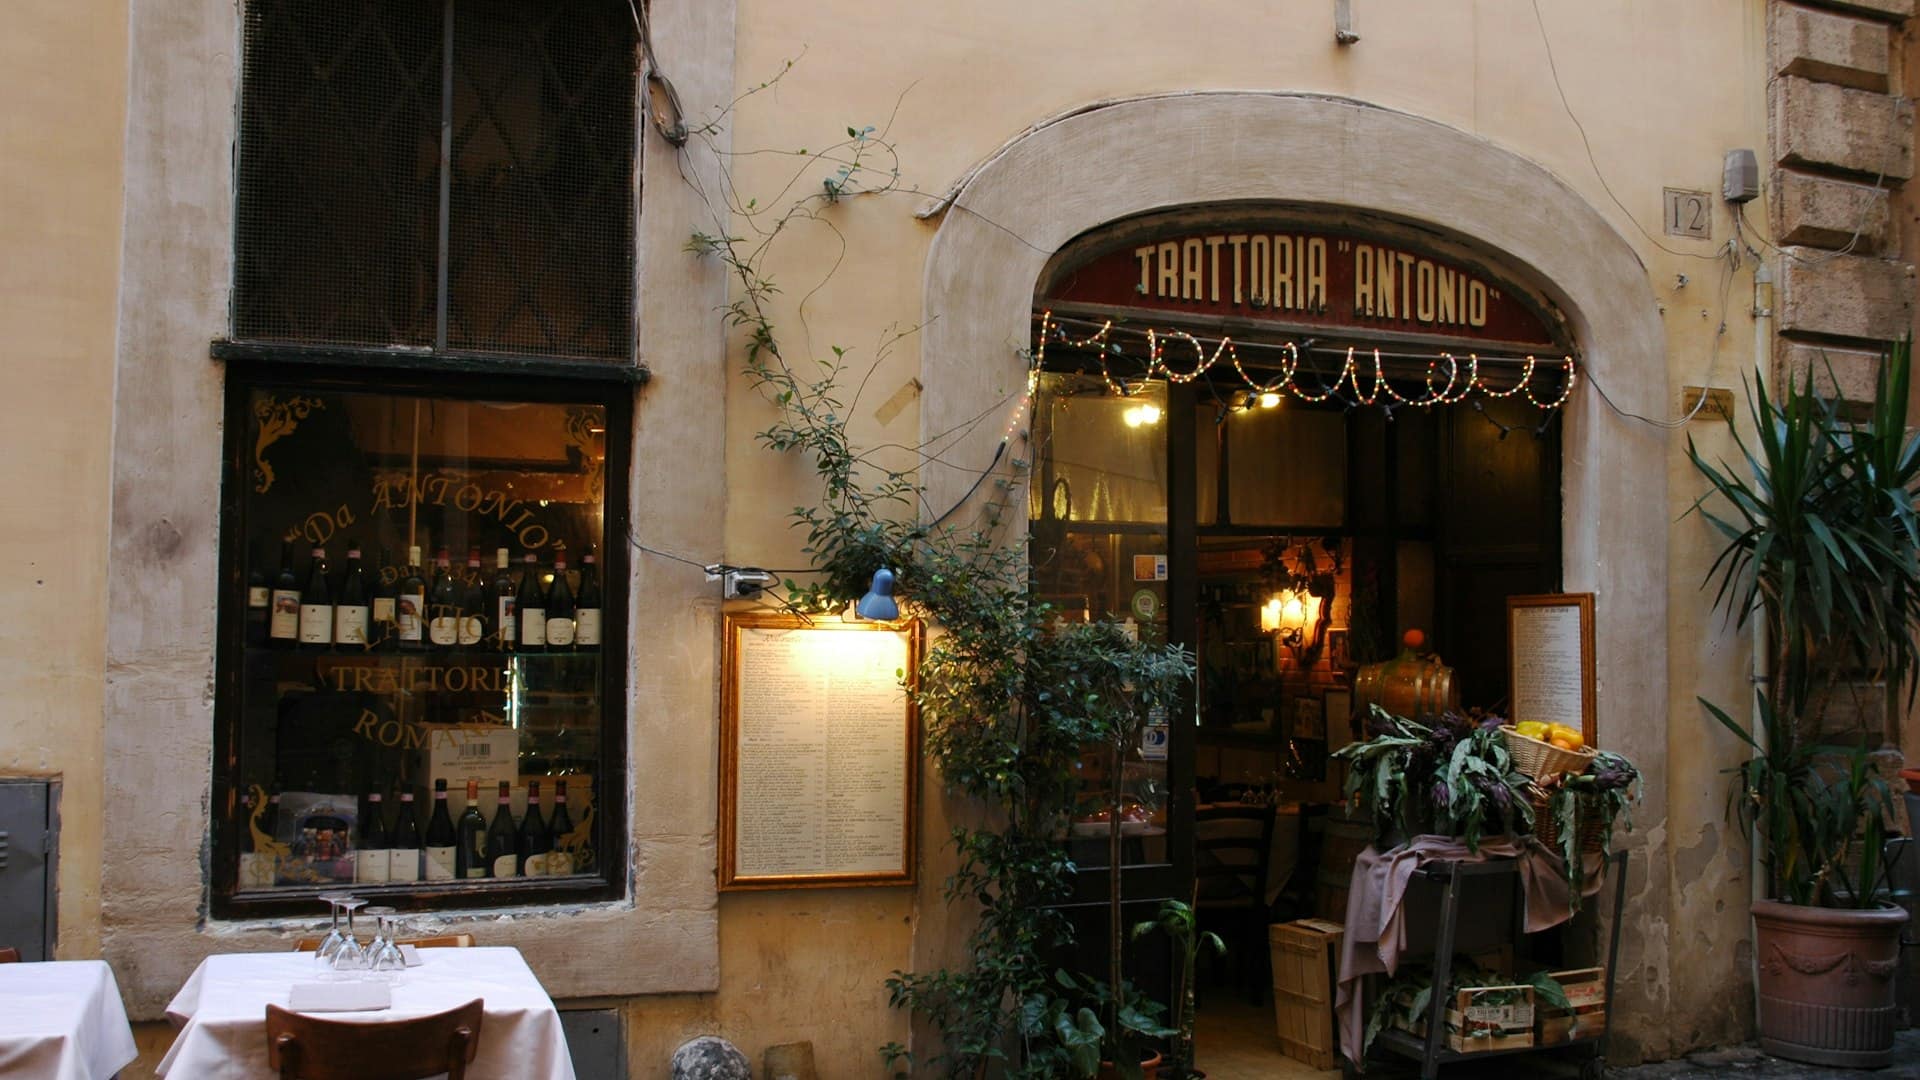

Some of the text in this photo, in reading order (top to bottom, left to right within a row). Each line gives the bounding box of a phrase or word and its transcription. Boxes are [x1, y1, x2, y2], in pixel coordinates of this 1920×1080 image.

[1673, 197, 1703, 230] 12
[1136, 234, 1500, 327] TRATTORIA "ANTONIO"
[332, 666, 528, 692] TRATTORIA
[353, 708, 506, 750] ROMANA
